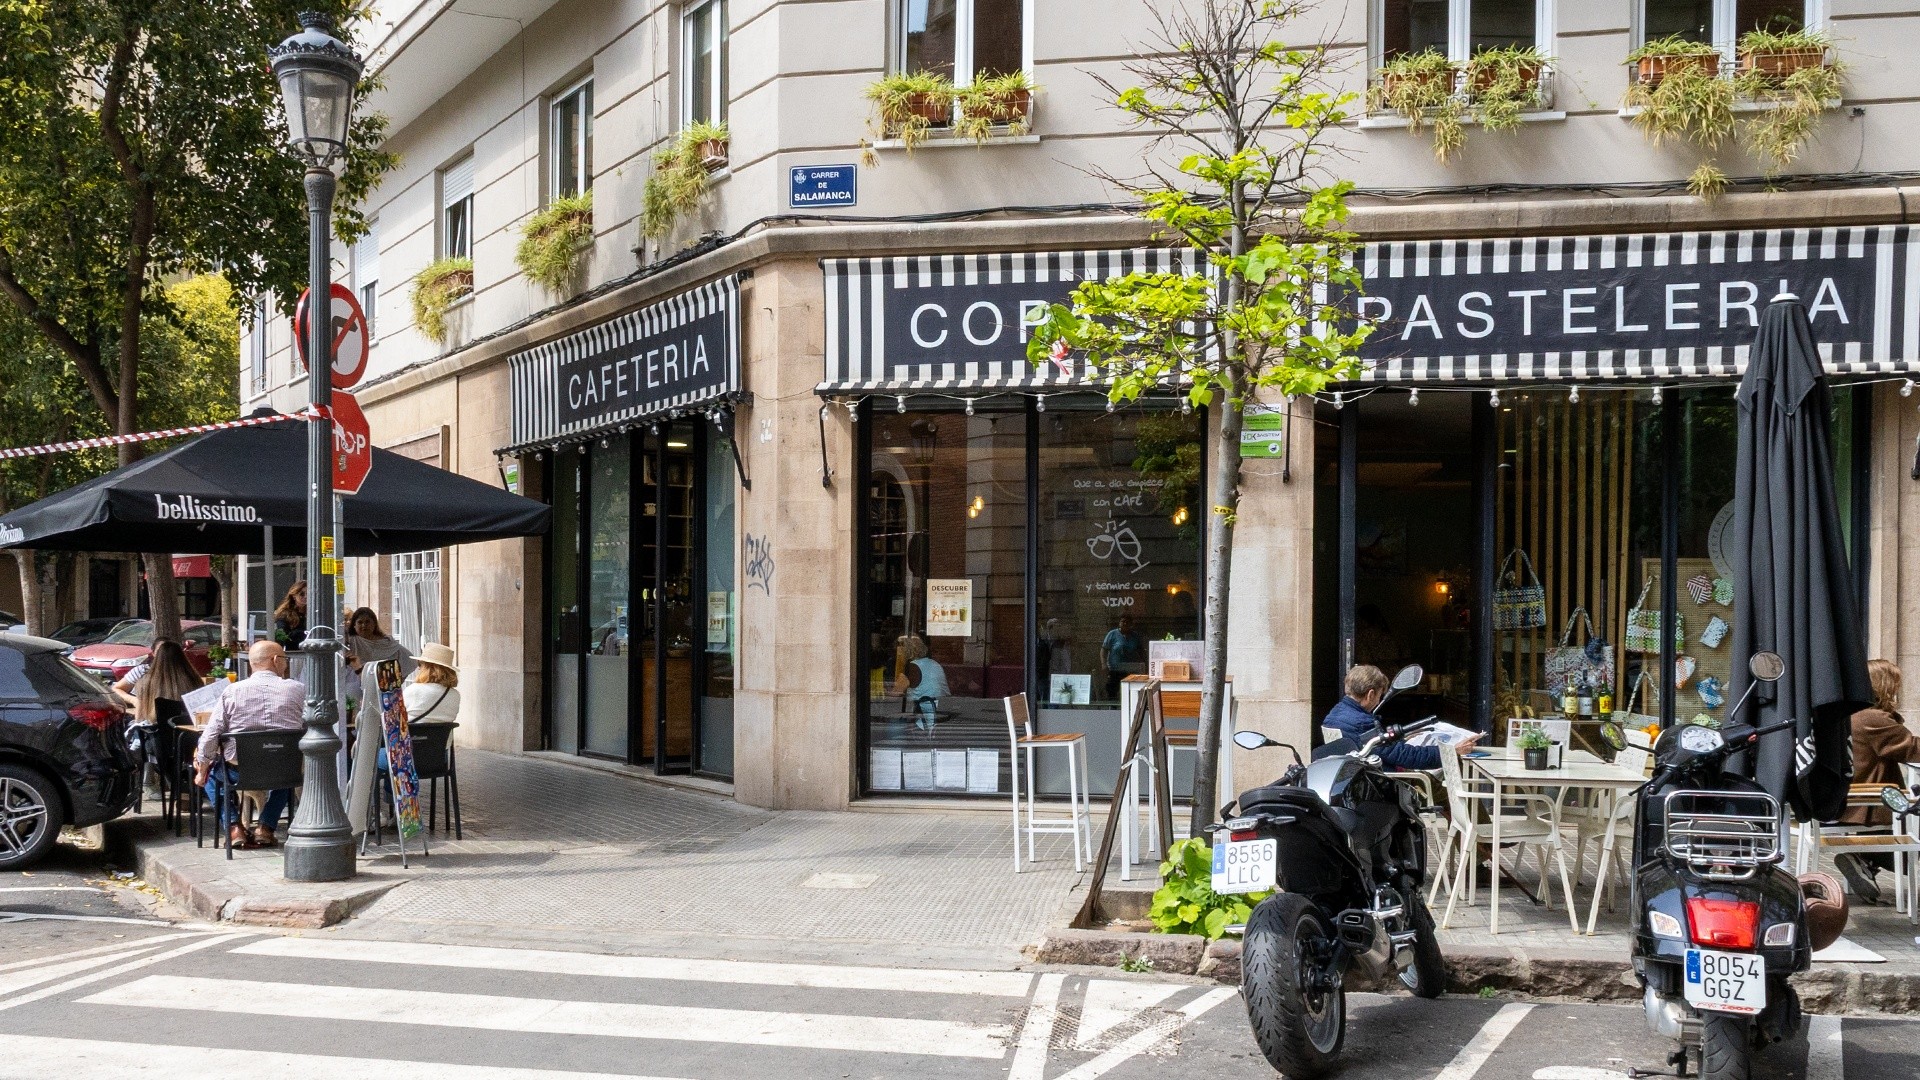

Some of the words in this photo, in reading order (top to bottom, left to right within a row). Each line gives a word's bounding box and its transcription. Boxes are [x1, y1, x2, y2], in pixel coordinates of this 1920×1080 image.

[811, 171, 839, 179] CARRER
[794, 191, 852, 201] SALAMANCA
[568, 334, 710, 410] CAFETERIA
[332, 428, 366, 455] TOP
[1073, 479, 1092, 489] Que
[1093, 499, 1111, 507] con
[1133, 582, 1151, 590] con
[1102, 596, 1135, 607] VINO
[1228, 843, 1273, 864] 8556
[1216, 862, 1222, 870] E
[1227, 864, 1261, 885] LLC
[1703, 954, 1760, 979] 8054
[1690, 971, 1697, 979] E
[1703, 977, 1746, 1001] GGZ
